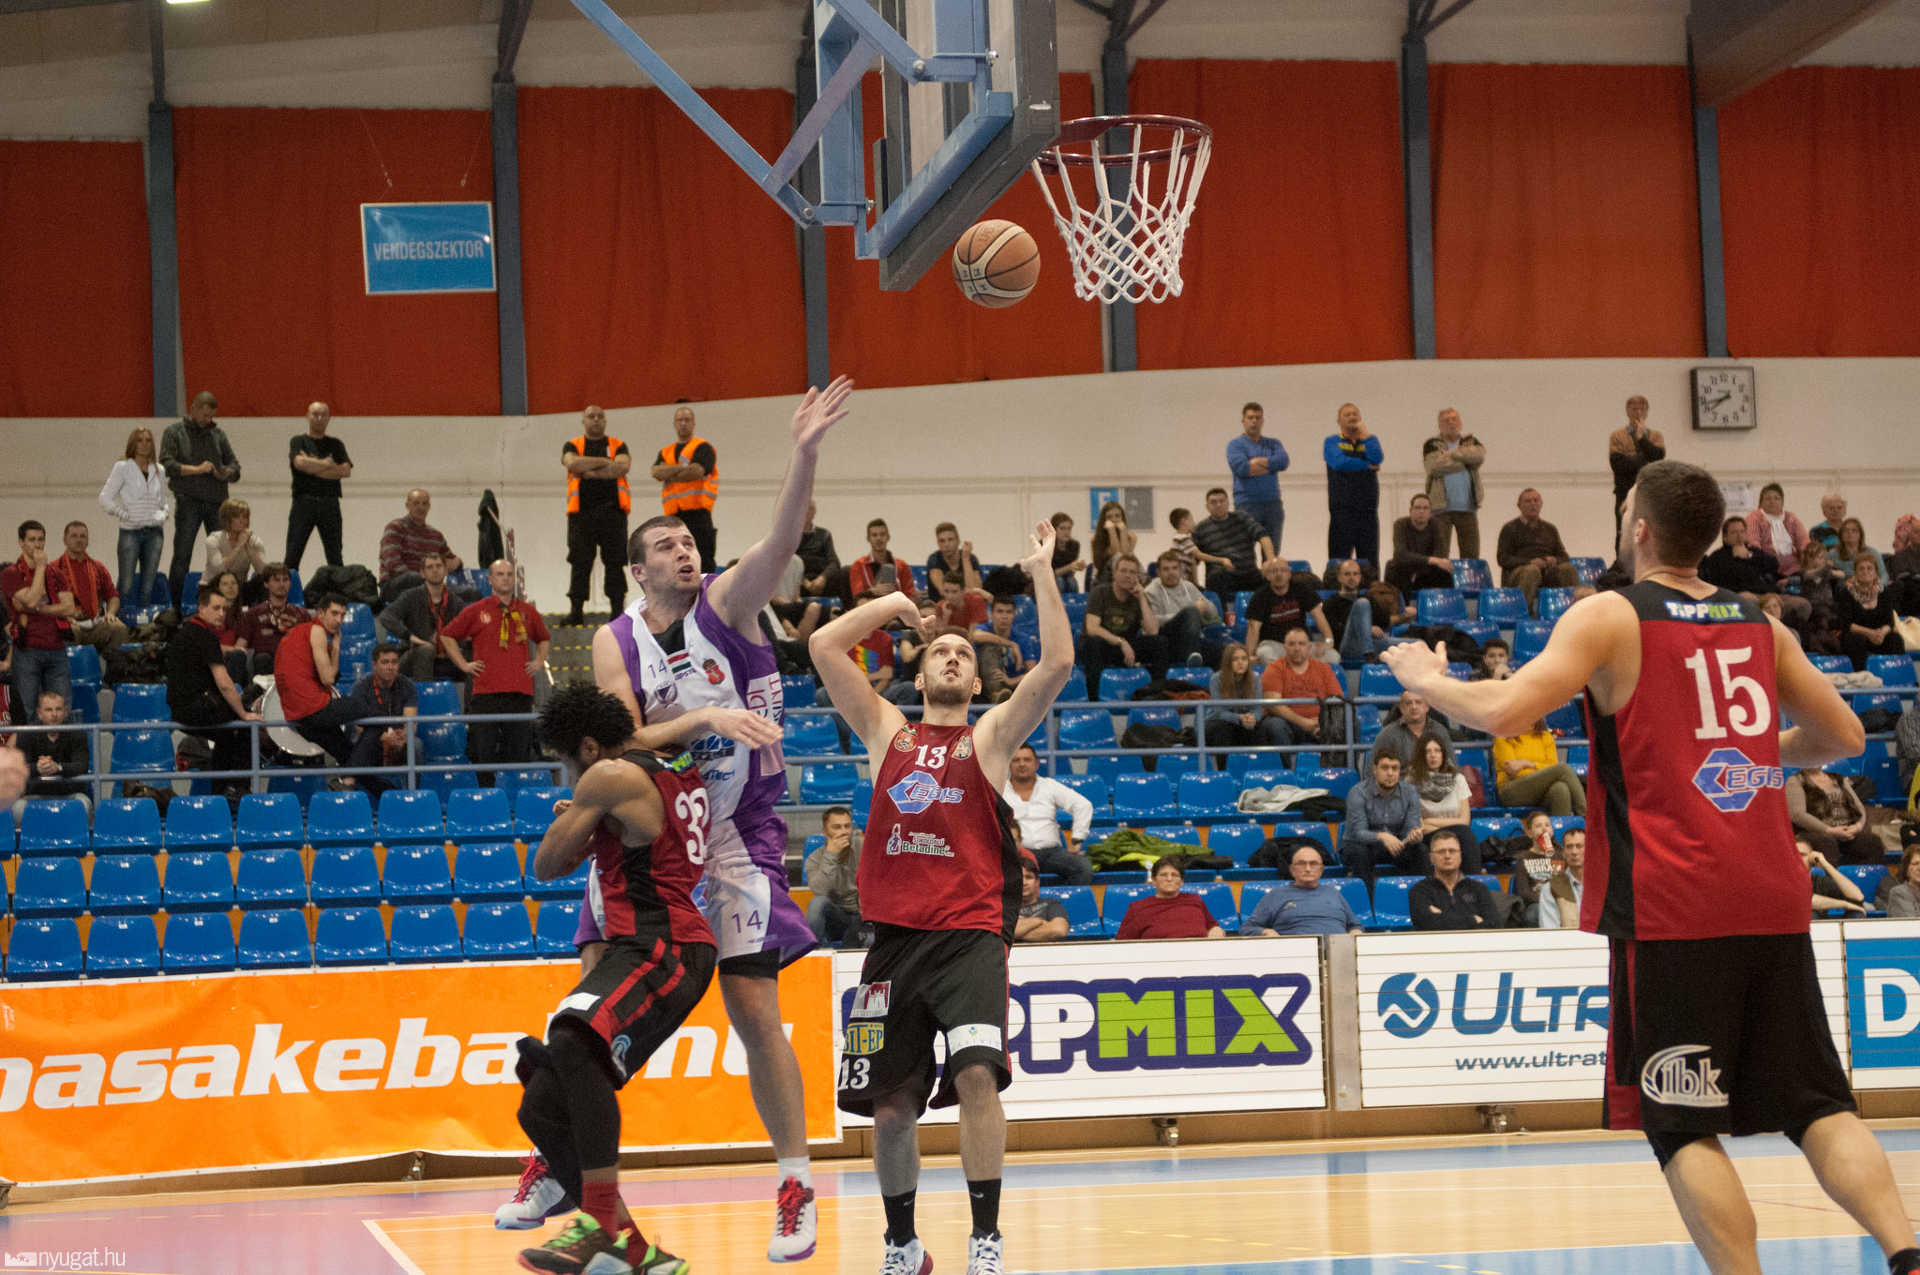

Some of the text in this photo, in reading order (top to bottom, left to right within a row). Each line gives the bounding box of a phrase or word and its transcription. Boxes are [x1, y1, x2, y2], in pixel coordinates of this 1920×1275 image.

[648, 658, 667, 679] 14
[1685, 646, 1772, 740] 15
[915, 744, 948, 769] 13
[731, 909, 763, 934] 14
[838, 1057, 871, 1092] 13
